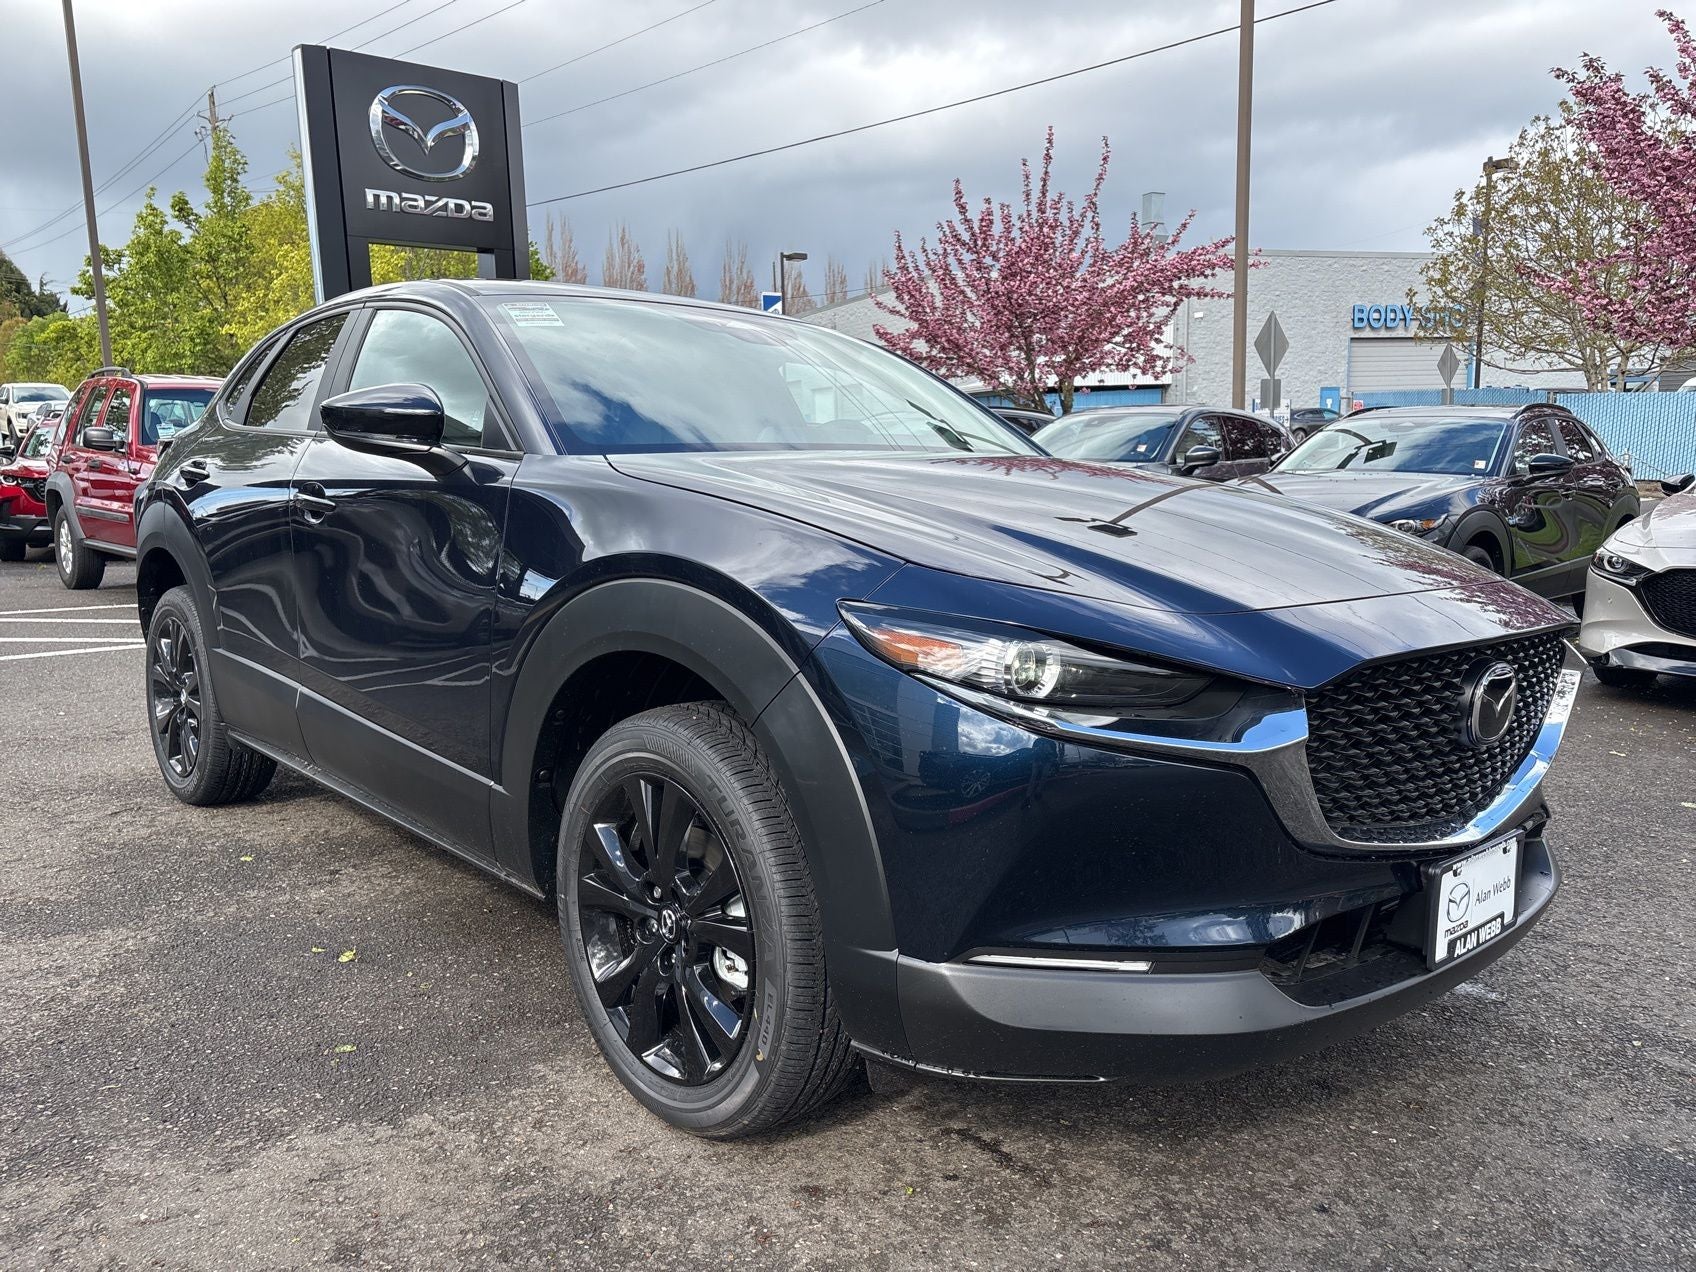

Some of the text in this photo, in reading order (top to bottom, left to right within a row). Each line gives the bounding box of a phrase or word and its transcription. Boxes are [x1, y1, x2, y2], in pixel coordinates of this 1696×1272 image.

[1353, 304, 1413, 328] BODY
[1474, 876, 1511, 906] Alan Webb
[1454, 917, 1502, 958] ALAN WEBB
